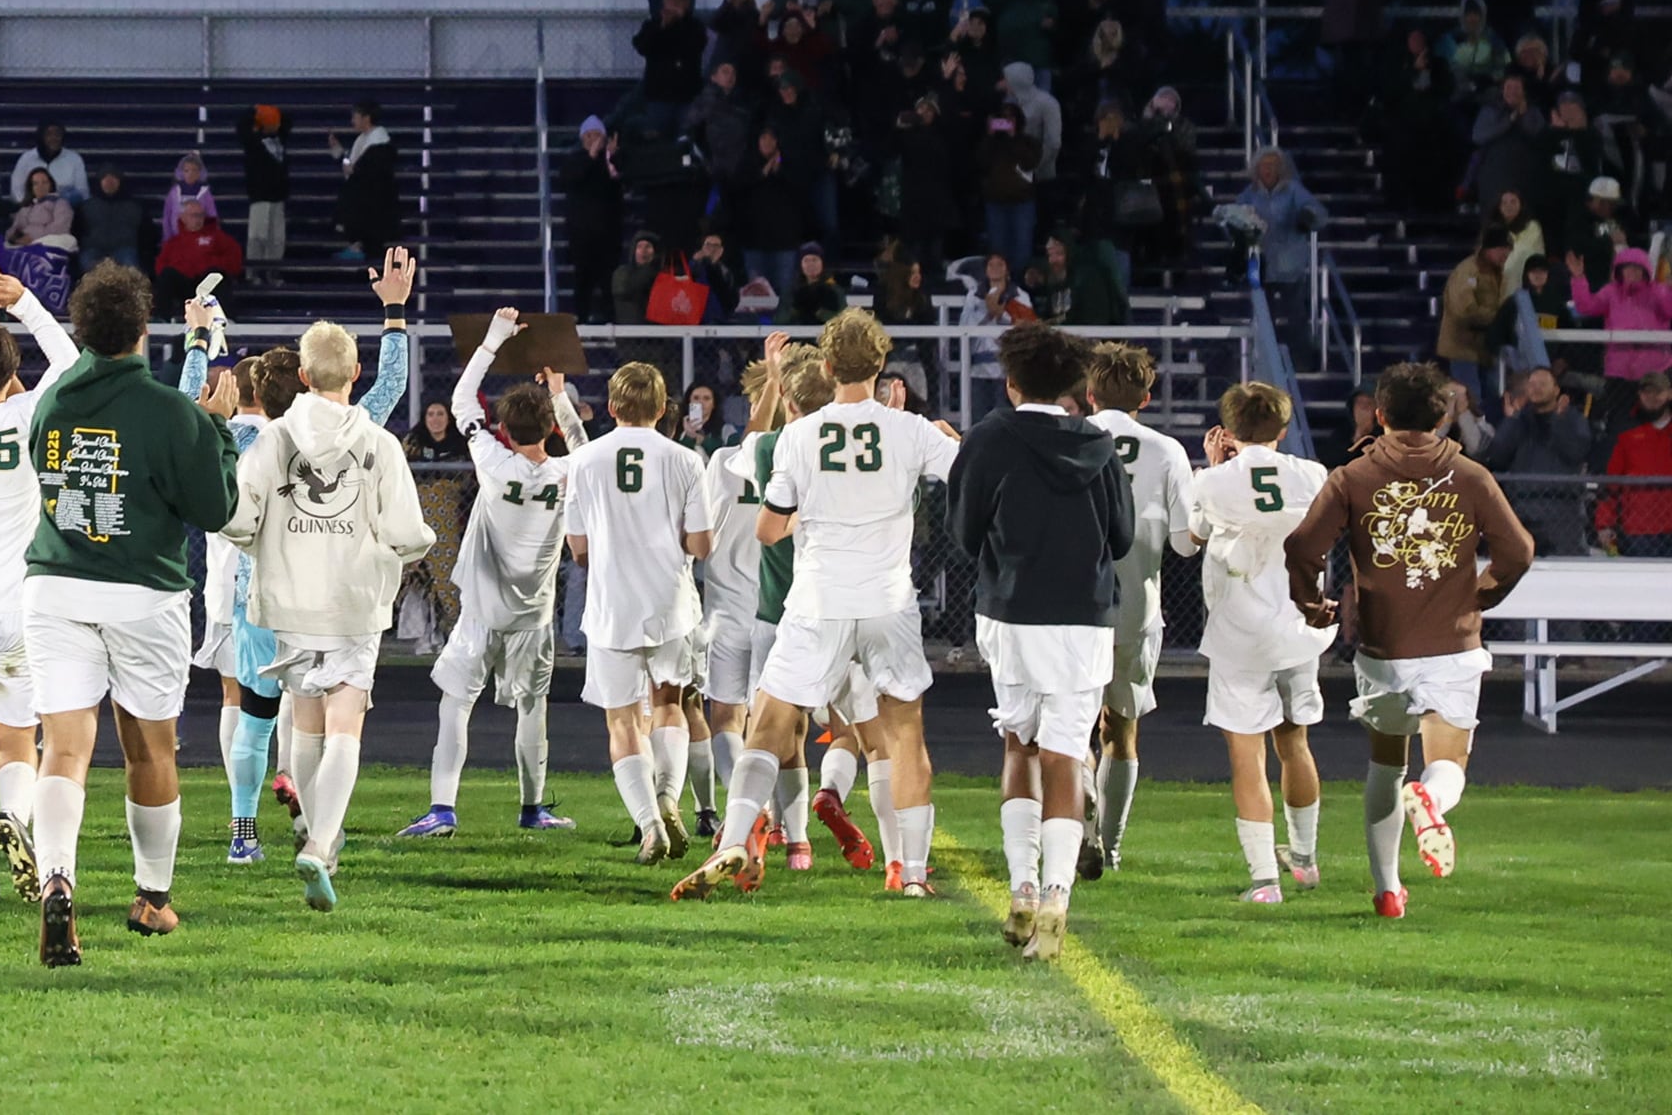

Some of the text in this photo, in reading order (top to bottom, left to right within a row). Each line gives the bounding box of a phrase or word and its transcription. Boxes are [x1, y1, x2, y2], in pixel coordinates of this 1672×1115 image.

[47, 430, 60, 470] 2025
[819, 421, 883, 473] 23
[615, 447, 644, 494] 6
[1250, 466, 1284, 513] 5
[502, 480, 560, 511] 14
[287, 516, 354, 534] GUINNESS
